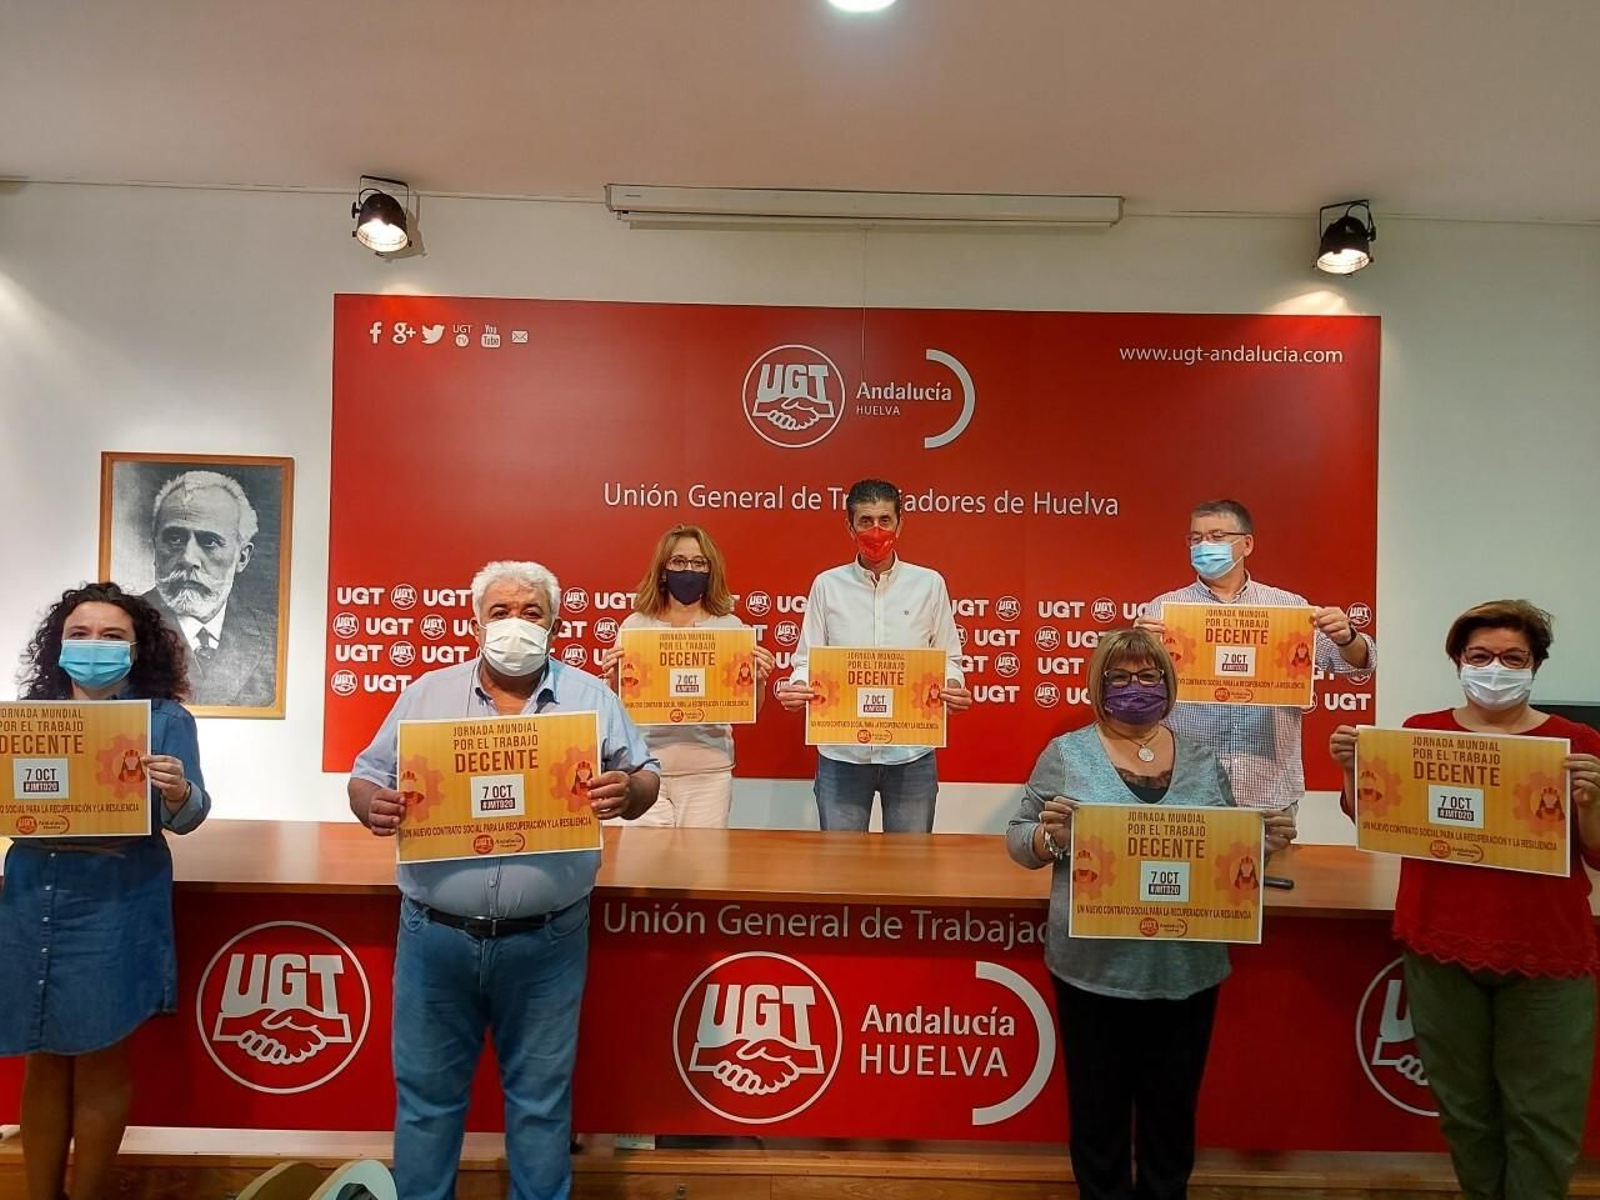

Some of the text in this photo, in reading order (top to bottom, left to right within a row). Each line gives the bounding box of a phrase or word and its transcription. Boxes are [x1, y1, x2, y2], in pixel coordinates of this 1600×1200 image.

[453, 324, 472, 334] UGT
[484, 324, 497, 335] You
[483, 335, 500, 346] Tube
[1119, 345, 1343, 365] www.ugt-andalucia.com
[757, 363, 830, 400] UGT
[855, 381, 953, 402] Andalucía
[855, 404, 901, 417] HUELVA
[603, 481, 1120, 517] Unión General de Tradores de Huelva
[336, 587, 472, 607] UGT UGT UGT
[566, 591, 586, 602] UGT
[750, 594, 768, 606] UGT
[776, 596, 808, 613] UG
[997, 600, 1018, 611] UGT
[1038, 601, 1086, 618] UGT
[1094, 602, 1114, 613] UGT
[336, 617, 356, 629] UGT
[365, 618, 414, 636] UGT
[423, 619, 443, 631] UGT
[596, 621, 617, 632] UGT
[778, 624, 798, 636] UGT
[1205, 618, 1269, 629] POR EL TRABAJO
[974, 629, 1021, 647] UGT
[1037, 630, 1058, 641] UGT
[1205, 628, 1269, 645] DECENTE
[335, 644, 470, 664] UGT UGT UGT
[565, 648, 585, 660] UGT
[659, 651, 716, 666] DECENTE
[1231, 653, 1247, 664] OCT
[997, 657, 1018, 668] UGT
[1037, 657, 1085, 674] UGT
[334, 674, 411, 693] UGT UGT
[847, 670, 905, 686] DECENTE
[871, 694, 885, 705] OCT
[973, 685, 1021, 703] UGT
[1036, 687, 1057, 697] UGT
[1324, 693, 1372, 711] UGT
[0, 707, 84, 719] ORNADA MUNDIAL
[20, 720, 33, 732] EL
[37, 720, 84, 732] TRABAJO
[453, 722, 538, 737] JORNADA MUNDIAL
[453, 735, 539, 751] POR EL TRABAJO
[1412, 736, 1500, 752] JORNADA MUNDIAL
[455, 749, 539, 773] DECENTE
[1413, 748, 1500, 765] POR EL TRABAJO
[25, 768, 58, 781] 7 OCT
[1413, 761, 1501, 787] DECENTE
[482, 785, 513, 799] 7 OCT
[1440, 795, 1472, 810] 7 OCT
[1127, 811, 1206, 824] JORNADA MUNDIAL
[1127, 824, 1206, 837] POR EL TRABAJO
[1127, 837, 1205, 859] DECENTE
[1150, 871, 1180, 884] 7 OCT
[603, 902, 706, 935] Unión
[717, 904, 849, 938] General
[859, 907, 903, 940] de
[221, 953, 345, 1016] UGT
[698, 984, 817, 1047] UGT
[860, 1003, 1016, 1037] Andalucía
[859, 1043, 1009, 1078] HUELVA
